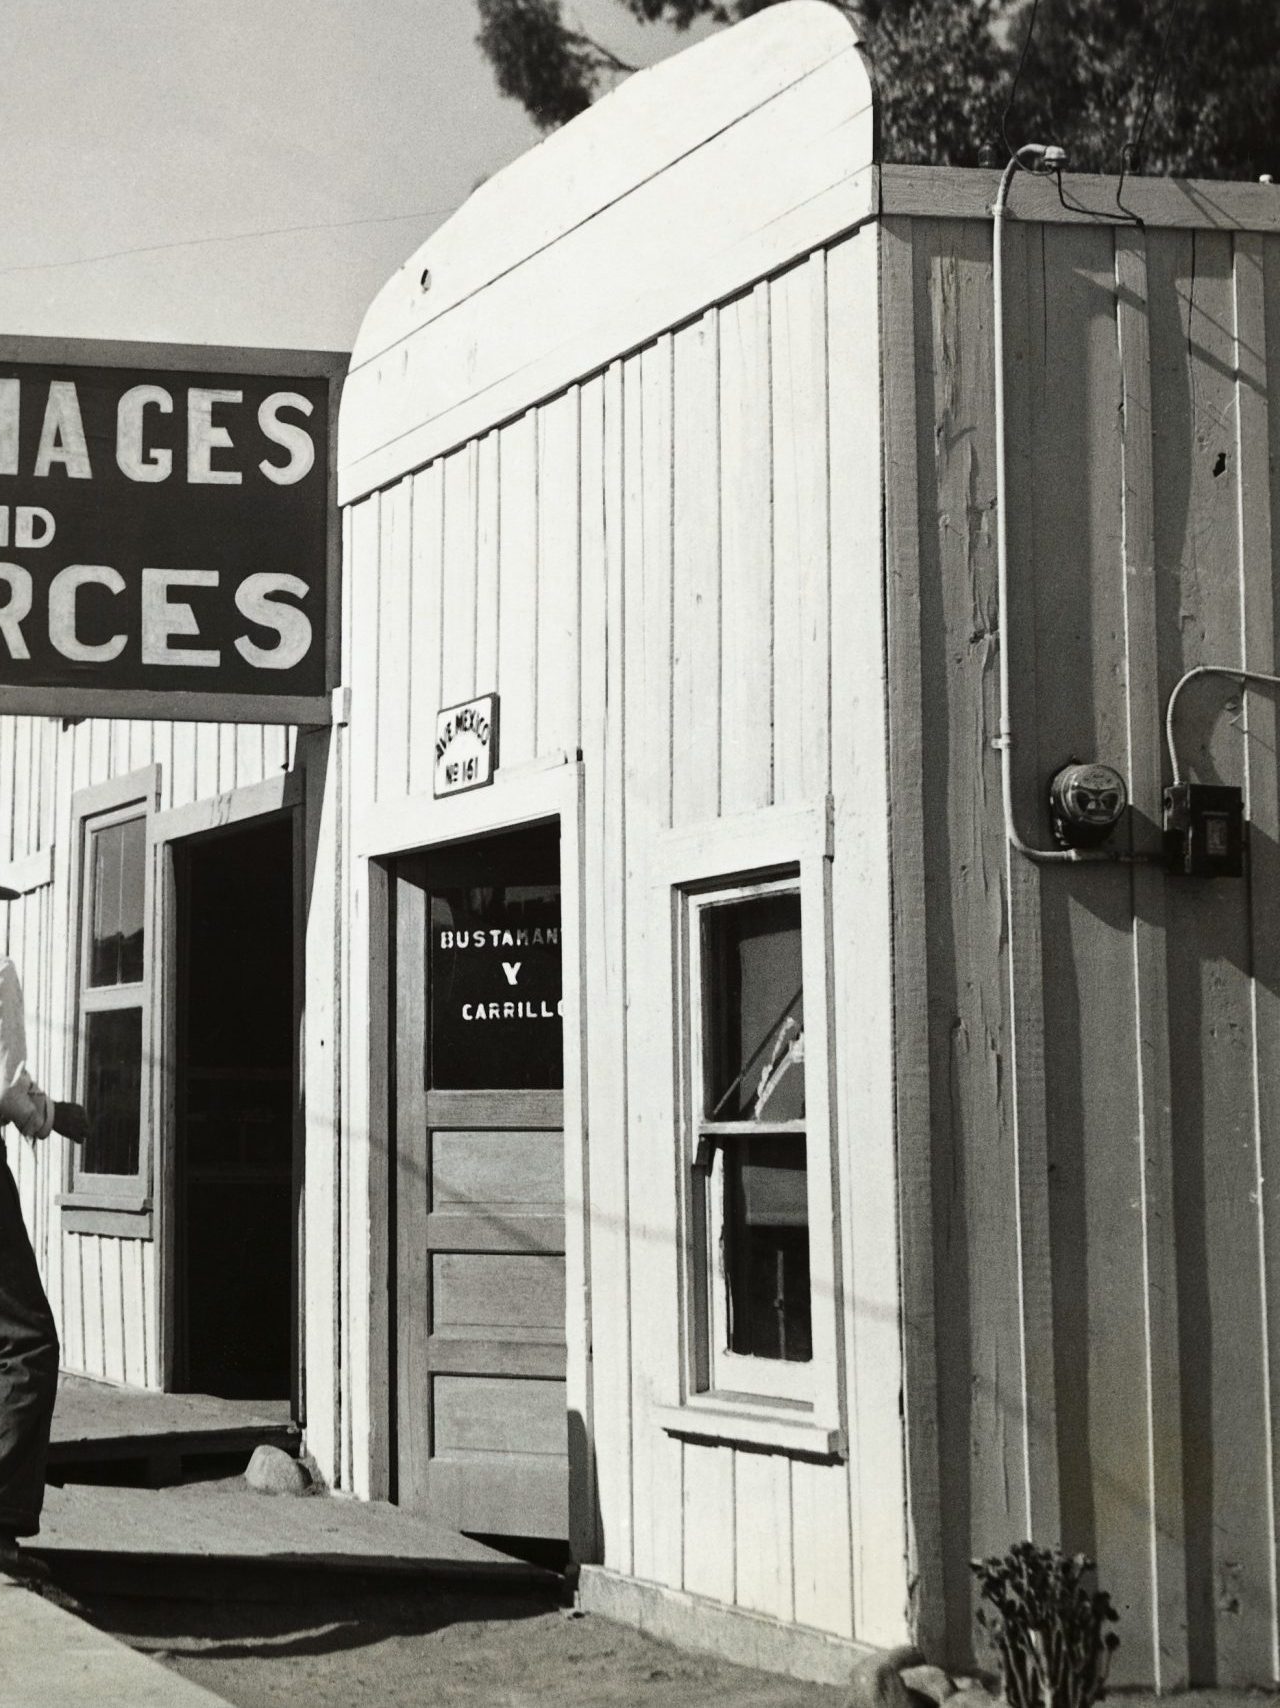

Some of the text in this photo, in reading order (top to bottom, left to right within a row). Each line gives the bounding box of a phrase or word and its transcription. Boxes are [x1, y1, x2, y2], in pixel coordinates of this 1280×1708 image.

[455, 708, 491, 746] MEXICO
[462, 756, 479, 782] 161
[440, 927, 562, 949] BUSTAMAN
[501, 961, 522, 986] Y
